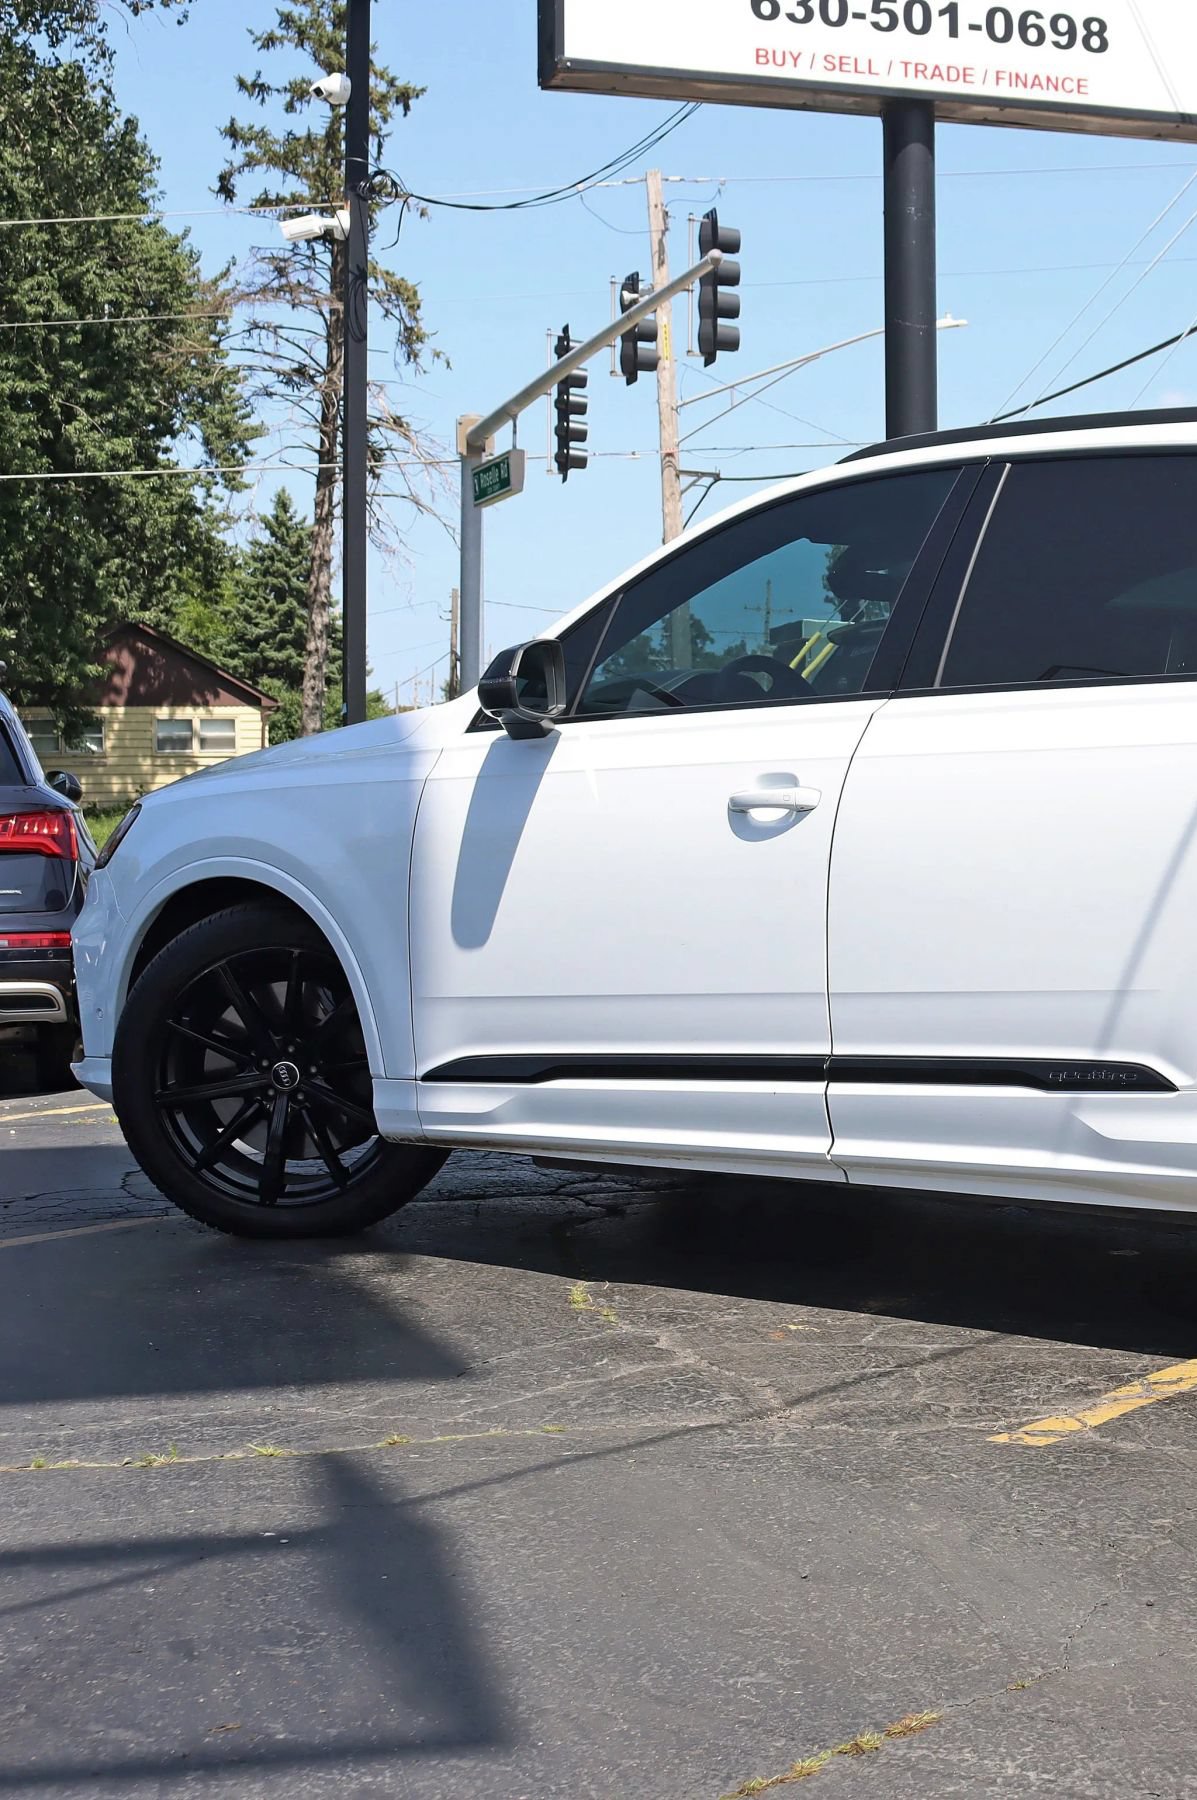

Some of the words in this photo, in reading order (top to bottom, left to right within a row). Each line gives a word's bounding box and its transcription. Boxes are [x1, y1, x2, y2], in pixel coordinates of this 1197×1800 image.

[755, 48, 802, 68] BUY
[823, 54, 880, 75] SELL
[900, 61, 975, 83] TRADE
[995, 70, 1089, 95] FINANCE
